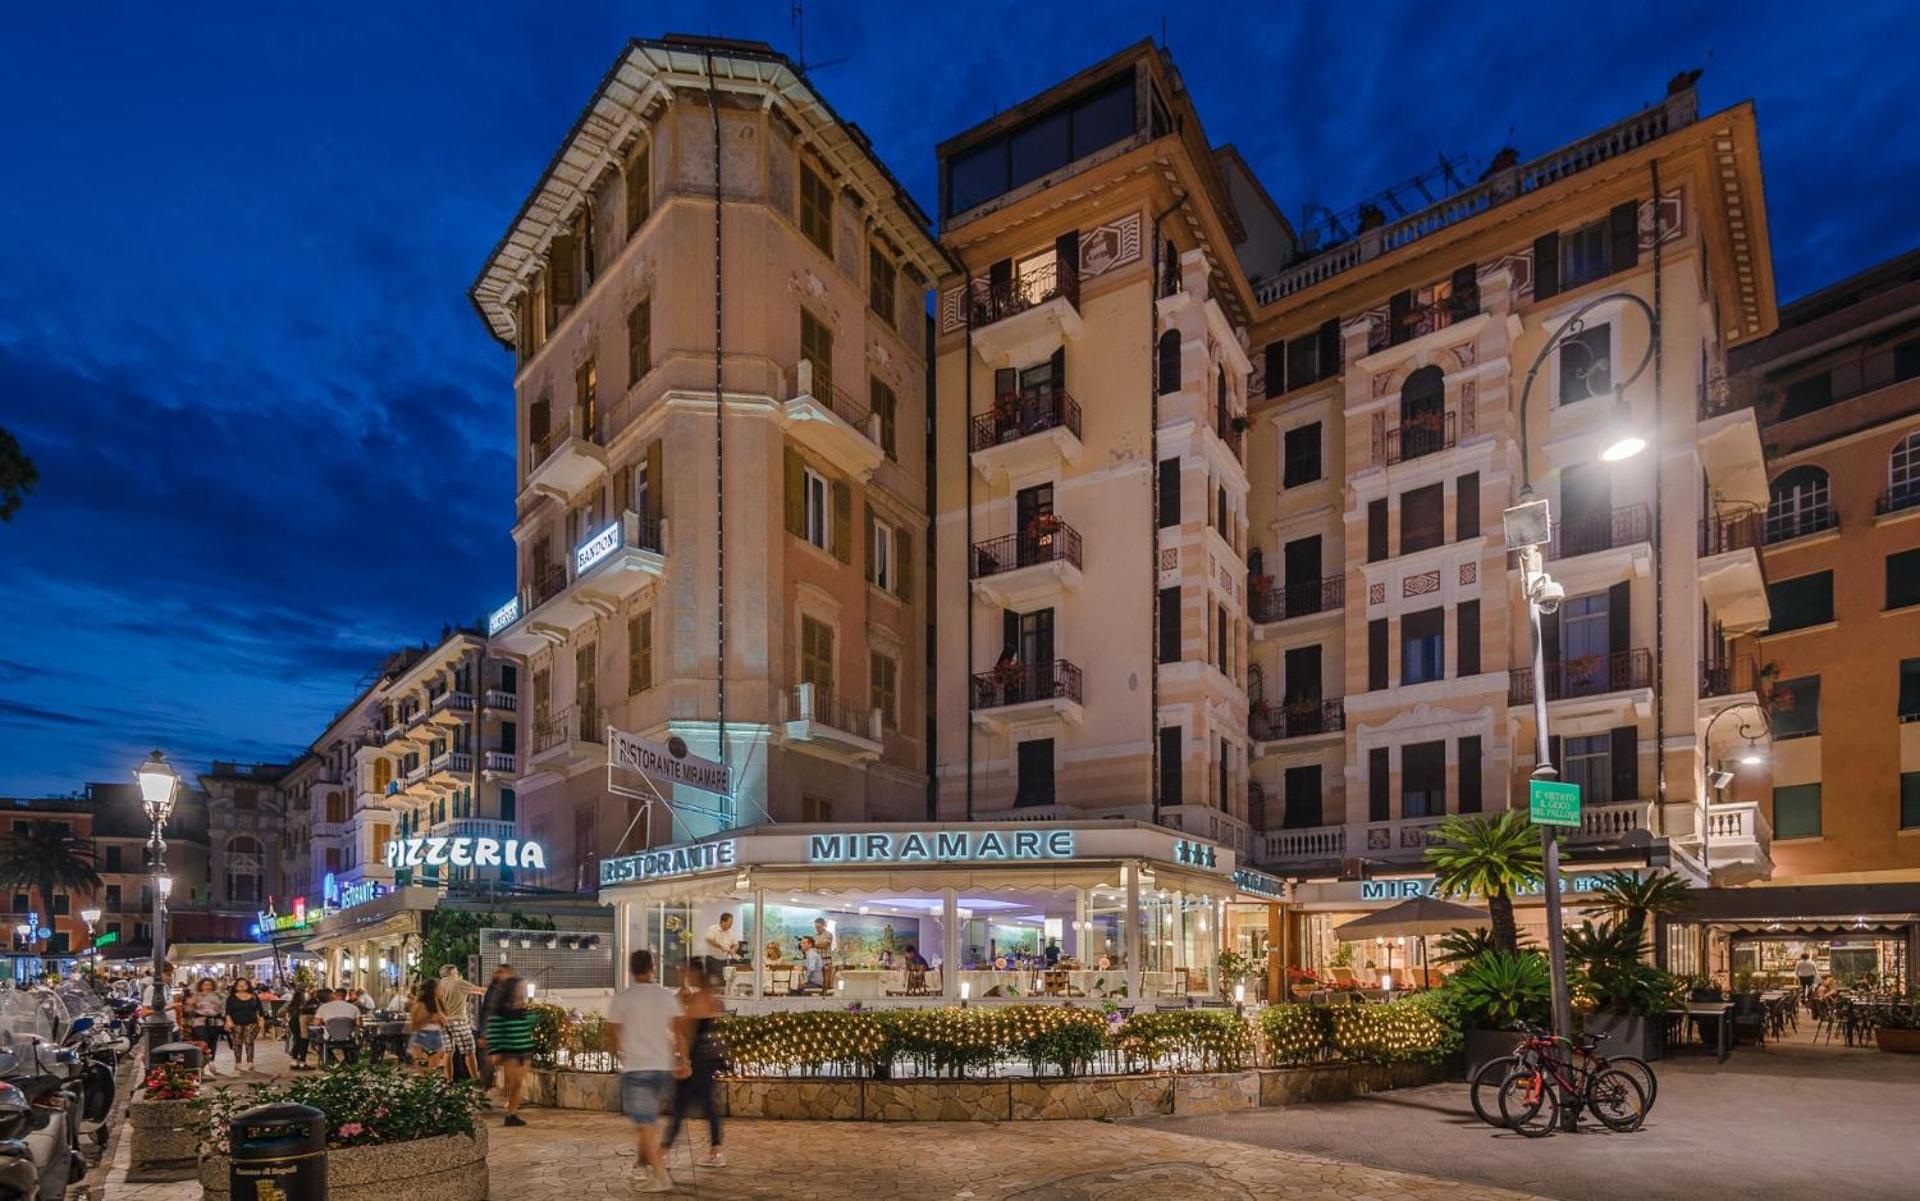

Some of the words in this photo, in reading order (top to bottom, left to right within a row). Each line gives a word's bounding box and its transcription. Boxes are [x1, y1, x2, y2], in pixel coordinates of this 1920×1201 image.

[619, 739, 681, 778] RISTORANTE
[682, 763, 727, 792] MIRAMARE
[387, 837, 546, 868] PIZZERIA
[601, 841, 732, 881] RISTORANTE
[811, 831, 1071, 859] MIRAMARE
